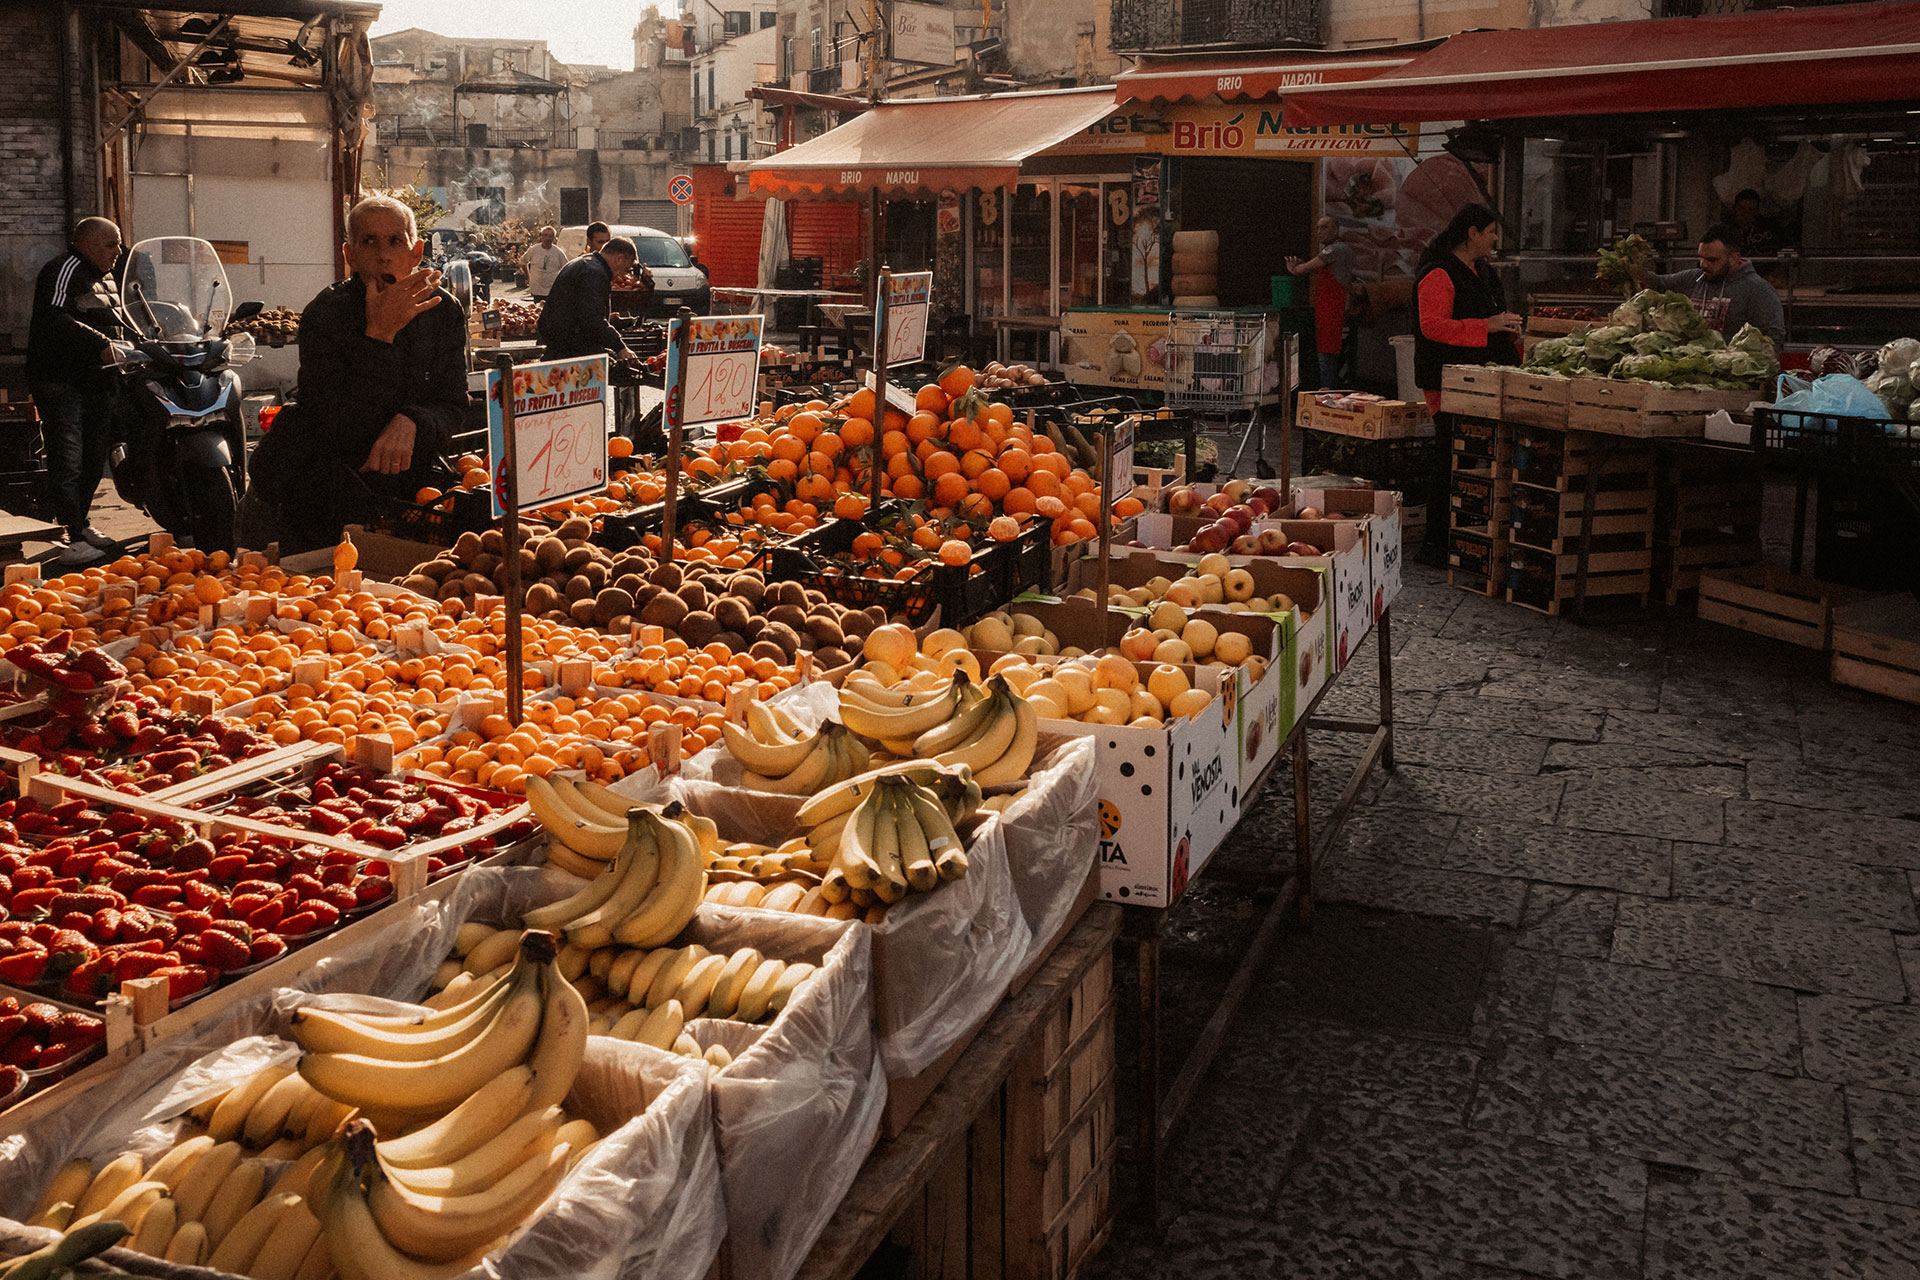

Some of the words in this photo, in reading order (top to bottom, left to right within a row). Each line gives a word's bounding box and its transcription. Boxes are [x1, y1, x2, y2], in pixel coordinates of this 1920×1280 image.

[896, 15, 917, 35] Bar
[1217, 76, 1242, 90] BRIO
[1281, 72, 1323, 87] NAPOLI
[1287, 139, 1371, 149] LATTICINI
[840, 171, 862, 183] BRIO
[886, 171, 919, 184] NAPOLI
[527, 394, 558, 412] FRUTTA
[593, 467, 602, 480] Kg
[1191, 753, 1222, 806] VENOSTA
